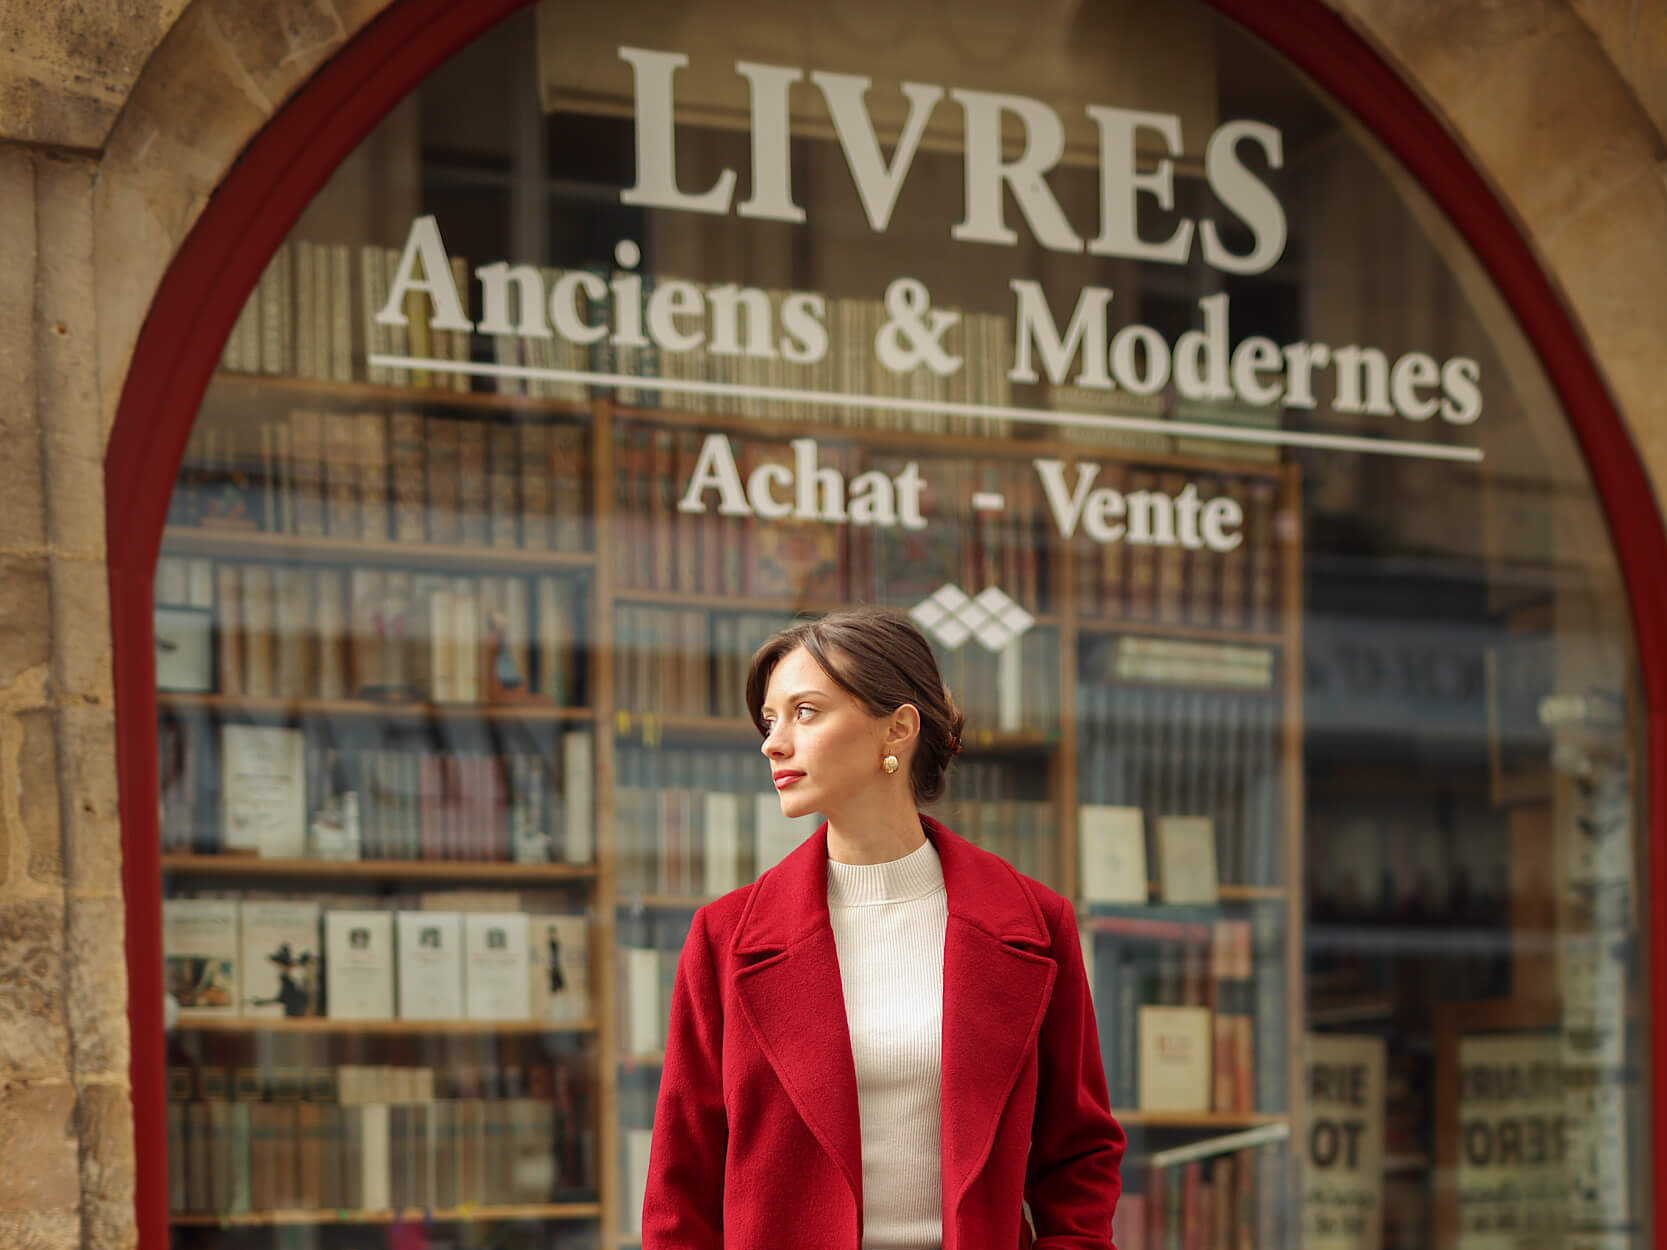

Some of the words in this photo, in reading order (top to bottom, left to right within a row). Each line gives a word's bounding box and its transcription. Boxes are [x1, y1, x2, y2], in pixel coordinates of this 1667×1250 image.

[618, 46, 1288, 277] LIVRES
[375, 214, 829, 365] Anciens
[875, 277, 963, 377] &
[1009, 280, 1482, 426] Modernes
[678, 433, 928, 529] Achat
[1035, 459, 1243, 552] Vente
